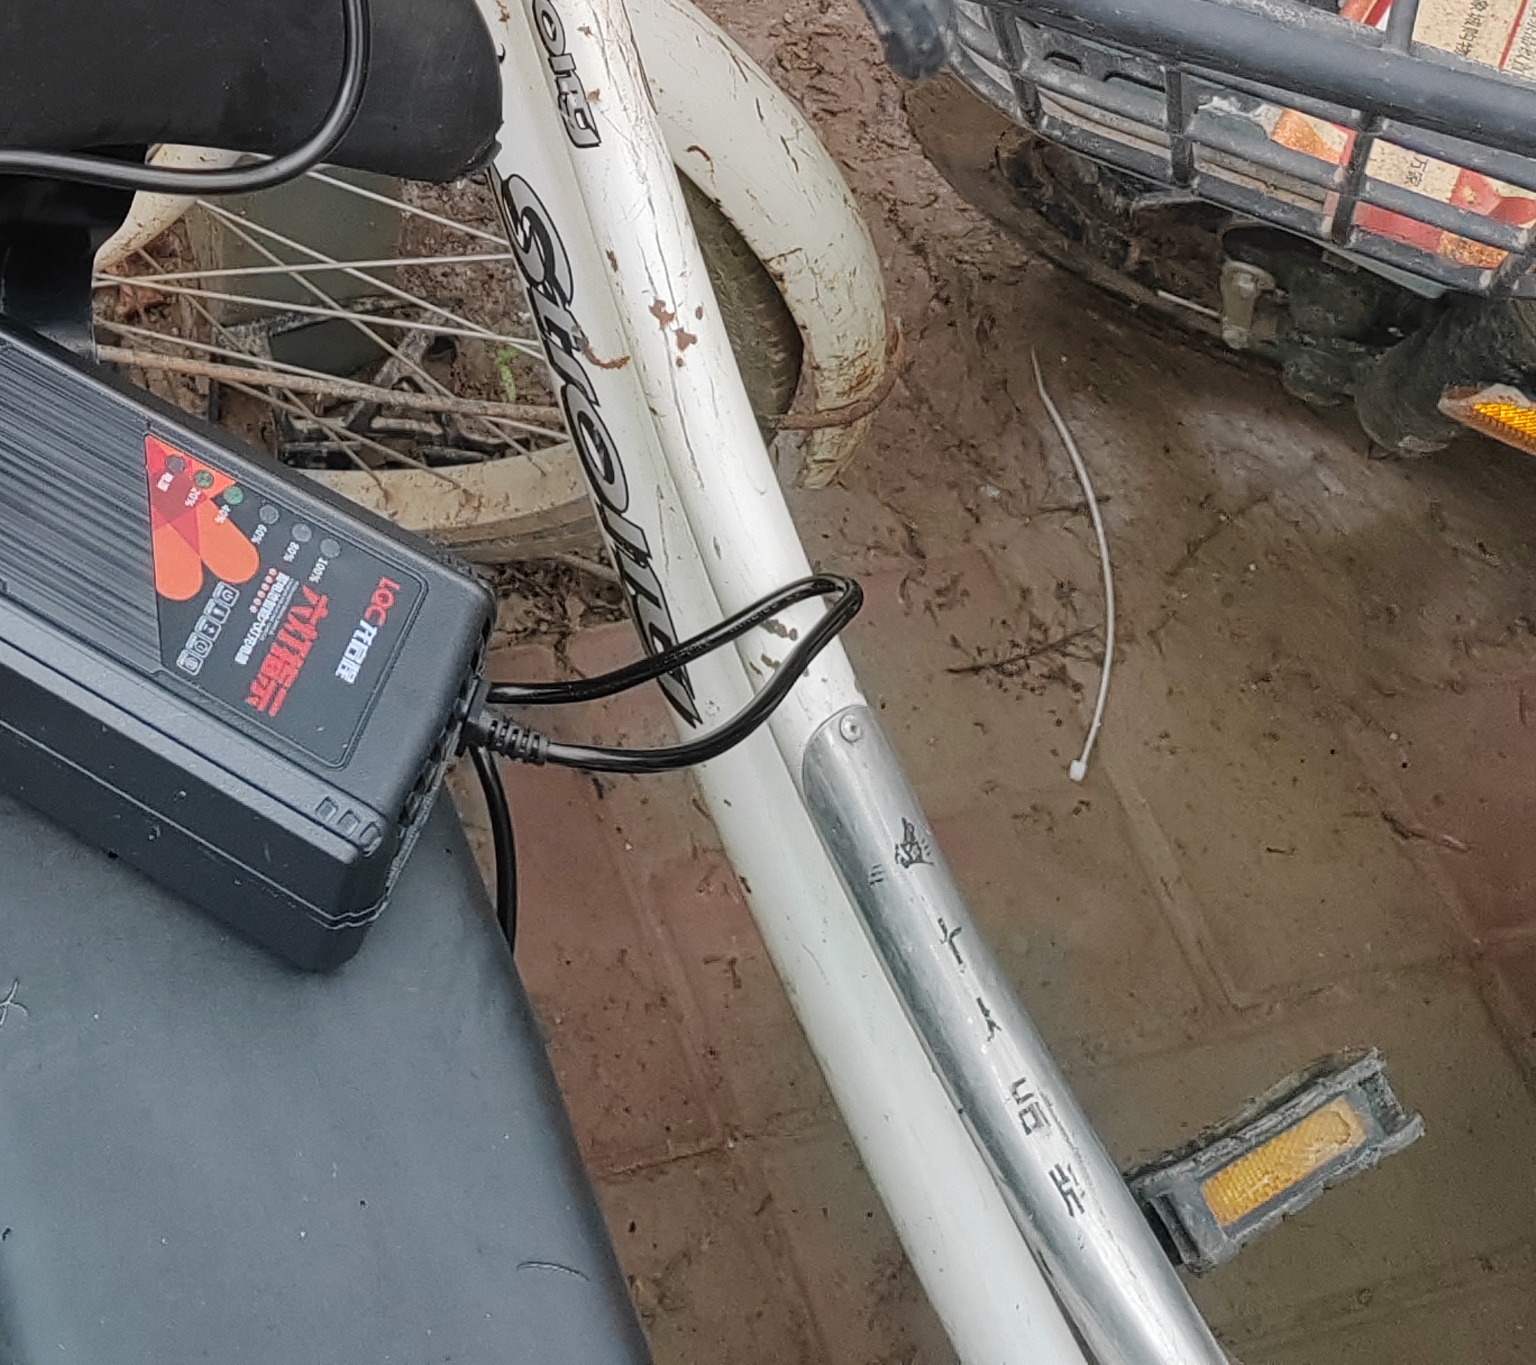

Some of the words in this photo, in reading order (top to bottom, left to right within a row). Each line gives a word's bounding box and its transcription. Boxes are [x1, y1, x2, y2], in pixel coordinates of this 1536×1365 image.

[184, 486, 202, 507] 20%
[214, 503, 232, 524] 40%
[250, 523, 268, 545] 60%
[283, 541, 300, 563] 80%
[309, 557, 329, 584] 100%
[245, 584, 330, 718] 六灯指示
